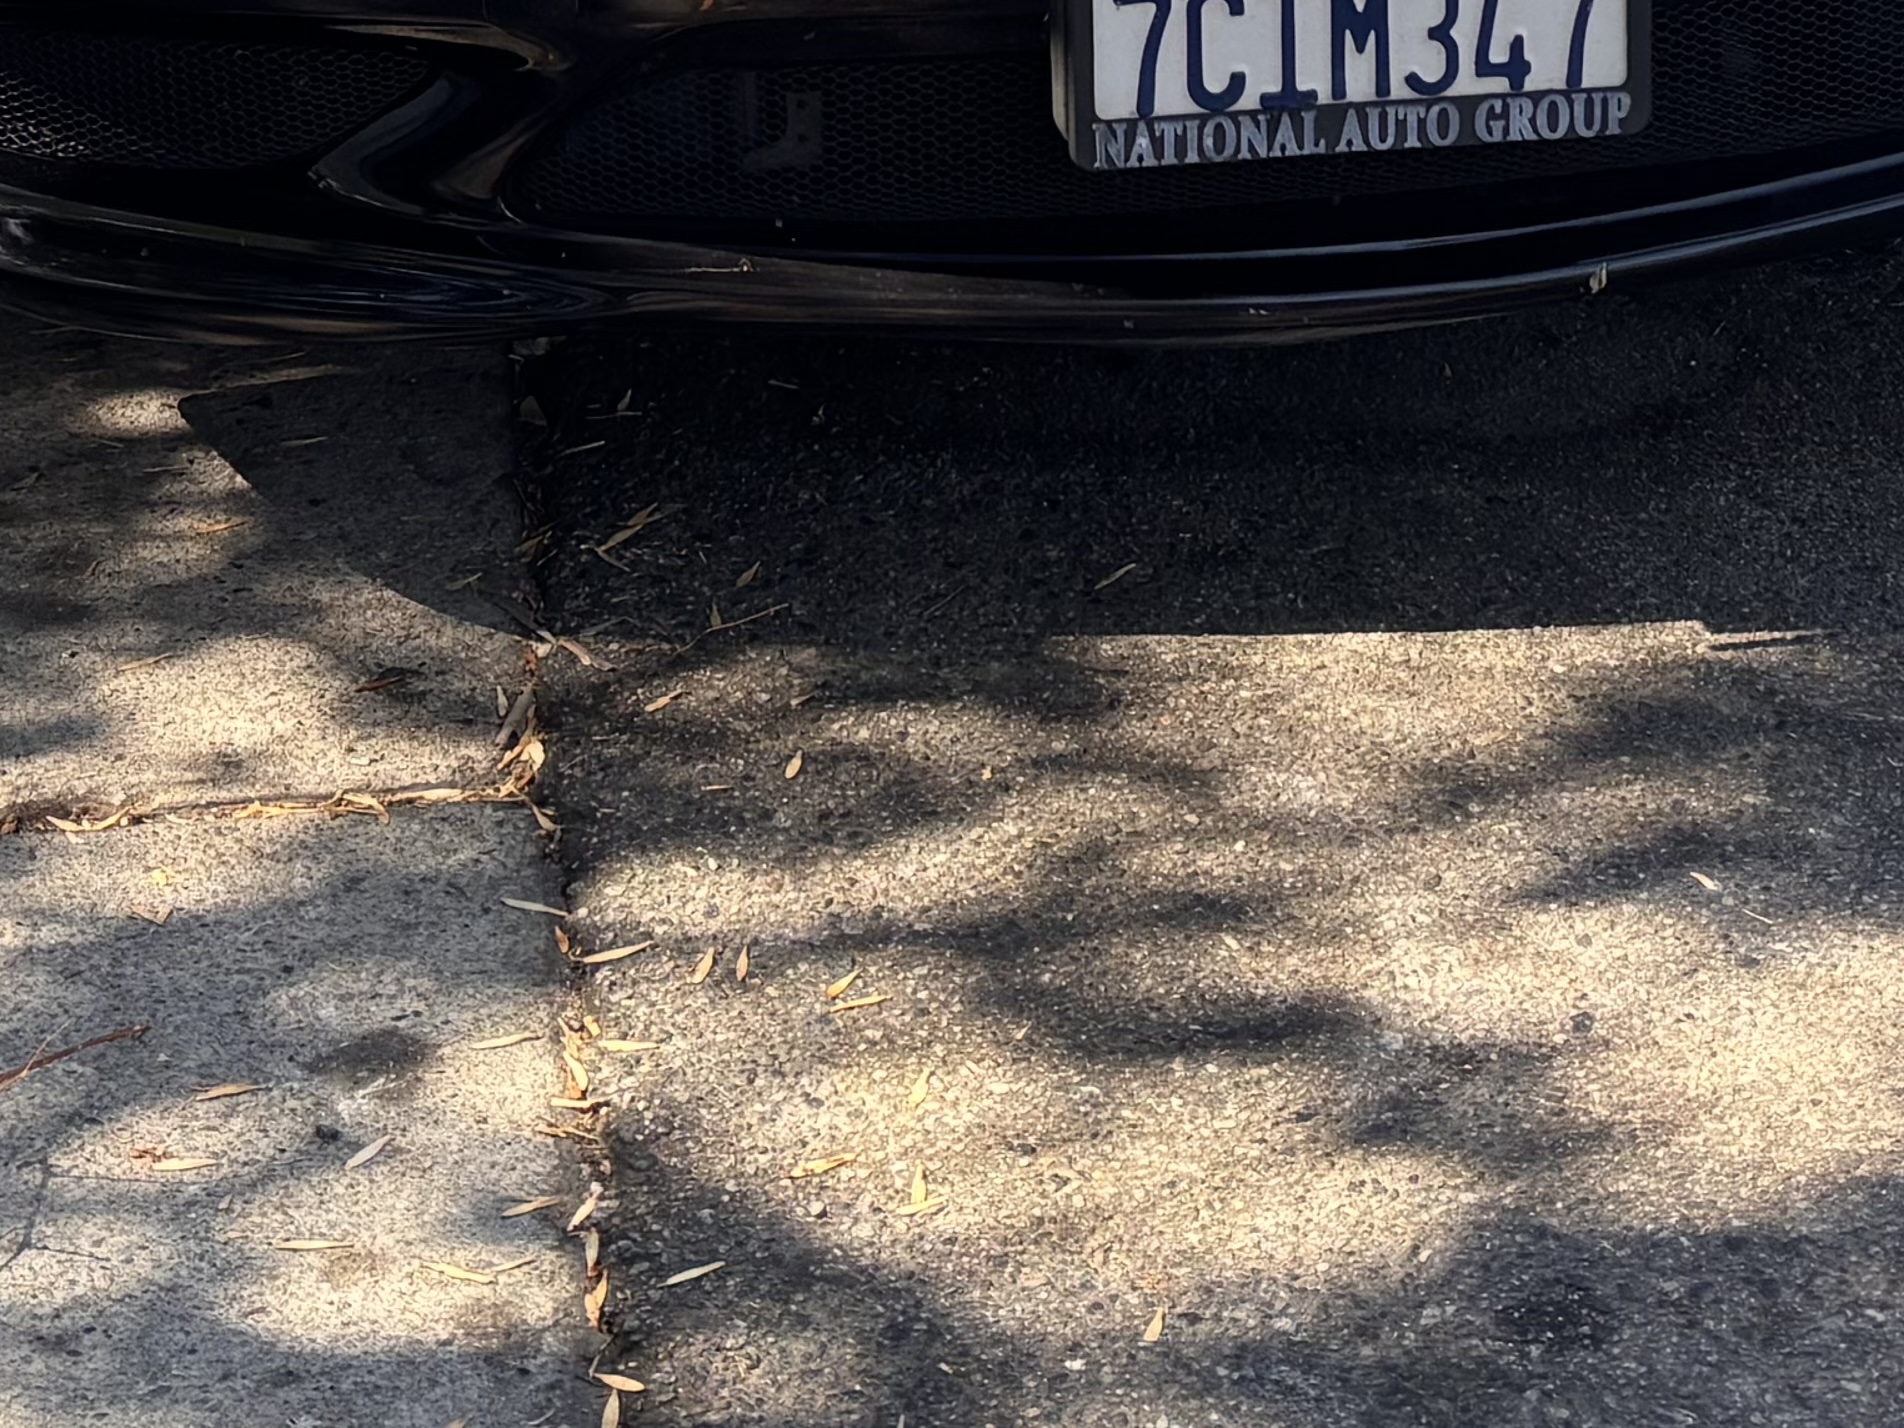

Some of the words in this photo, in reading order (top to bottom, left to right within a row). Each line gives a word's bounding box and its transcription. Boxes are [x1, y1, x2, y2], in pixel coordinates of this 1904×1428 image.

[1091, 107, 1327, 169] NATIONAL
[1334, 100, 1461, 153] AUTO
[1474, 91, 1632, 144] GROUP
